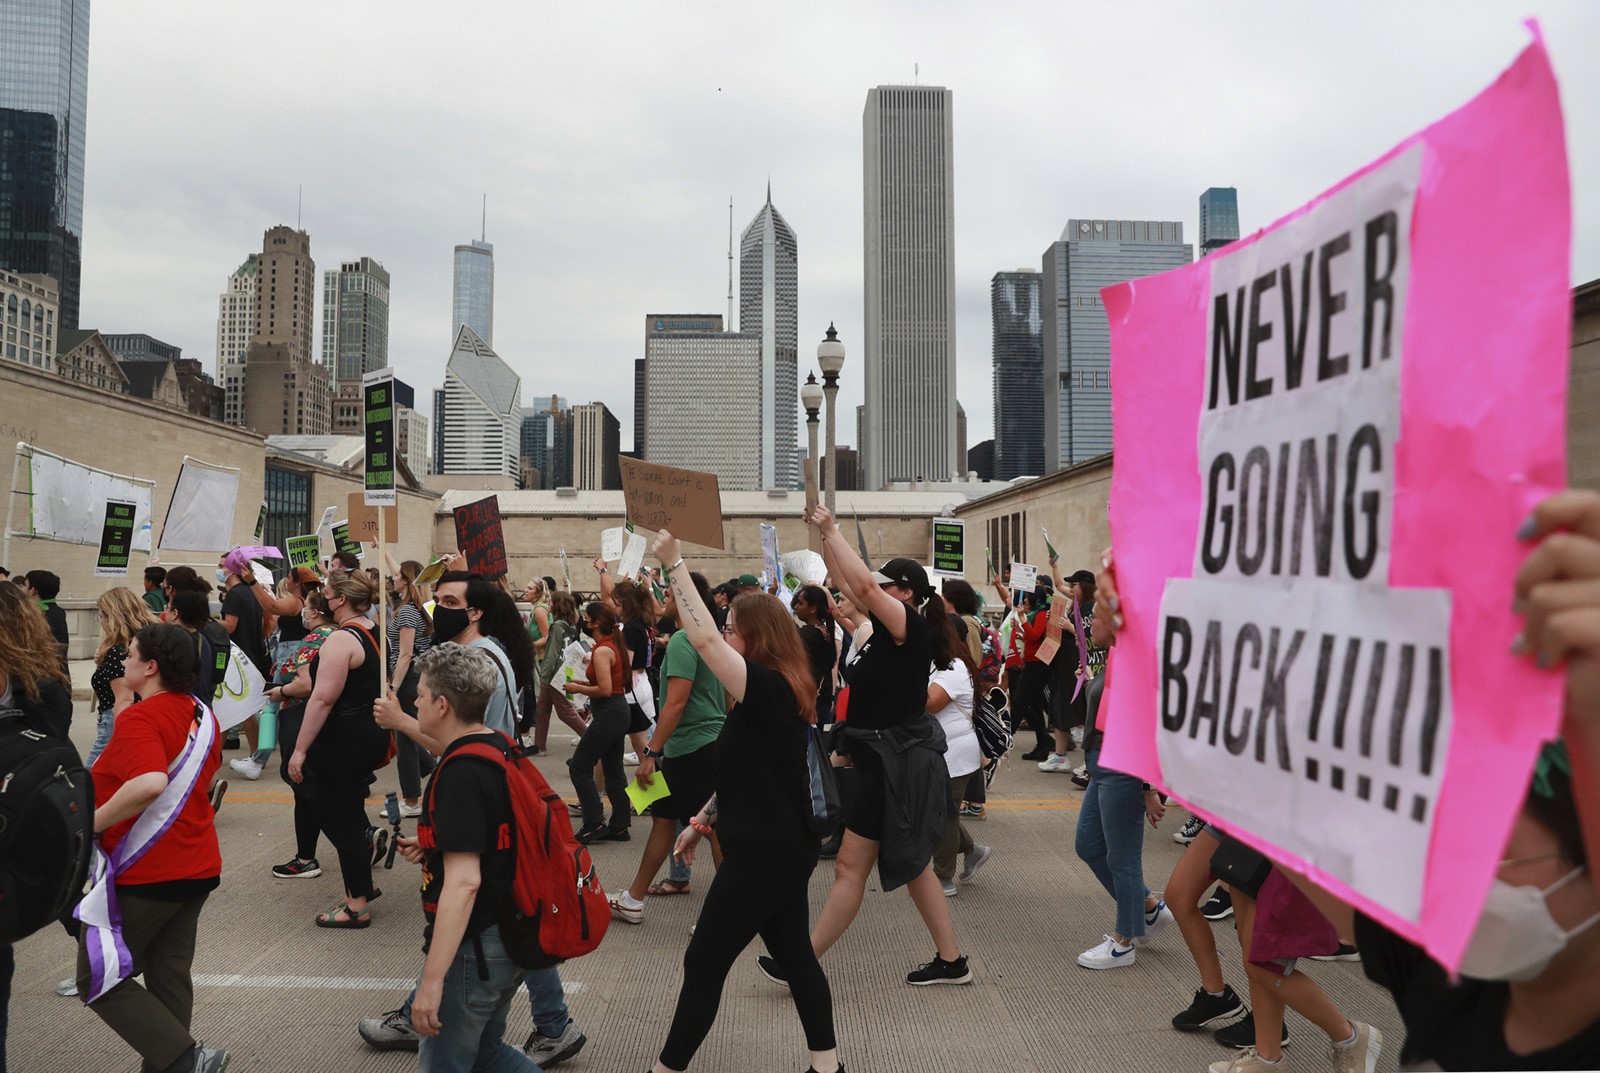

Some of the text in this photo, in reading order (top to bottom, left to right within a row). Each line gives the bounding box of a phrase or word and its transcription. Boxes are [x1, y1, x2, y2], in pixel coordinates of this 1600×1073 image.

[1208, 210, 1398, 410] NEVER
[371, 389, 386, 404] FORCED
[366, 407, 392, 424] MOTHERHOOD
[372, 452, 387, 467] FEMALE
[366, 471, 393, 485] ENSLAVEMENT
[668, 471, 692, 486] Court
[1201, 423, 1382, 580] GOING
[114, 507, 129, 516] FORCED
[106, 518, 133, 528] MOTHERHOOD
[108, 545, 124, 553] FEMALE
[288, 539, 318, 550] OVERTURN
[99, 555, 128, 565] ENSLAVEMENT
[290, 550, 309, 566] ROE
[1162, 615, 1442, 824] BACK!!!!!
